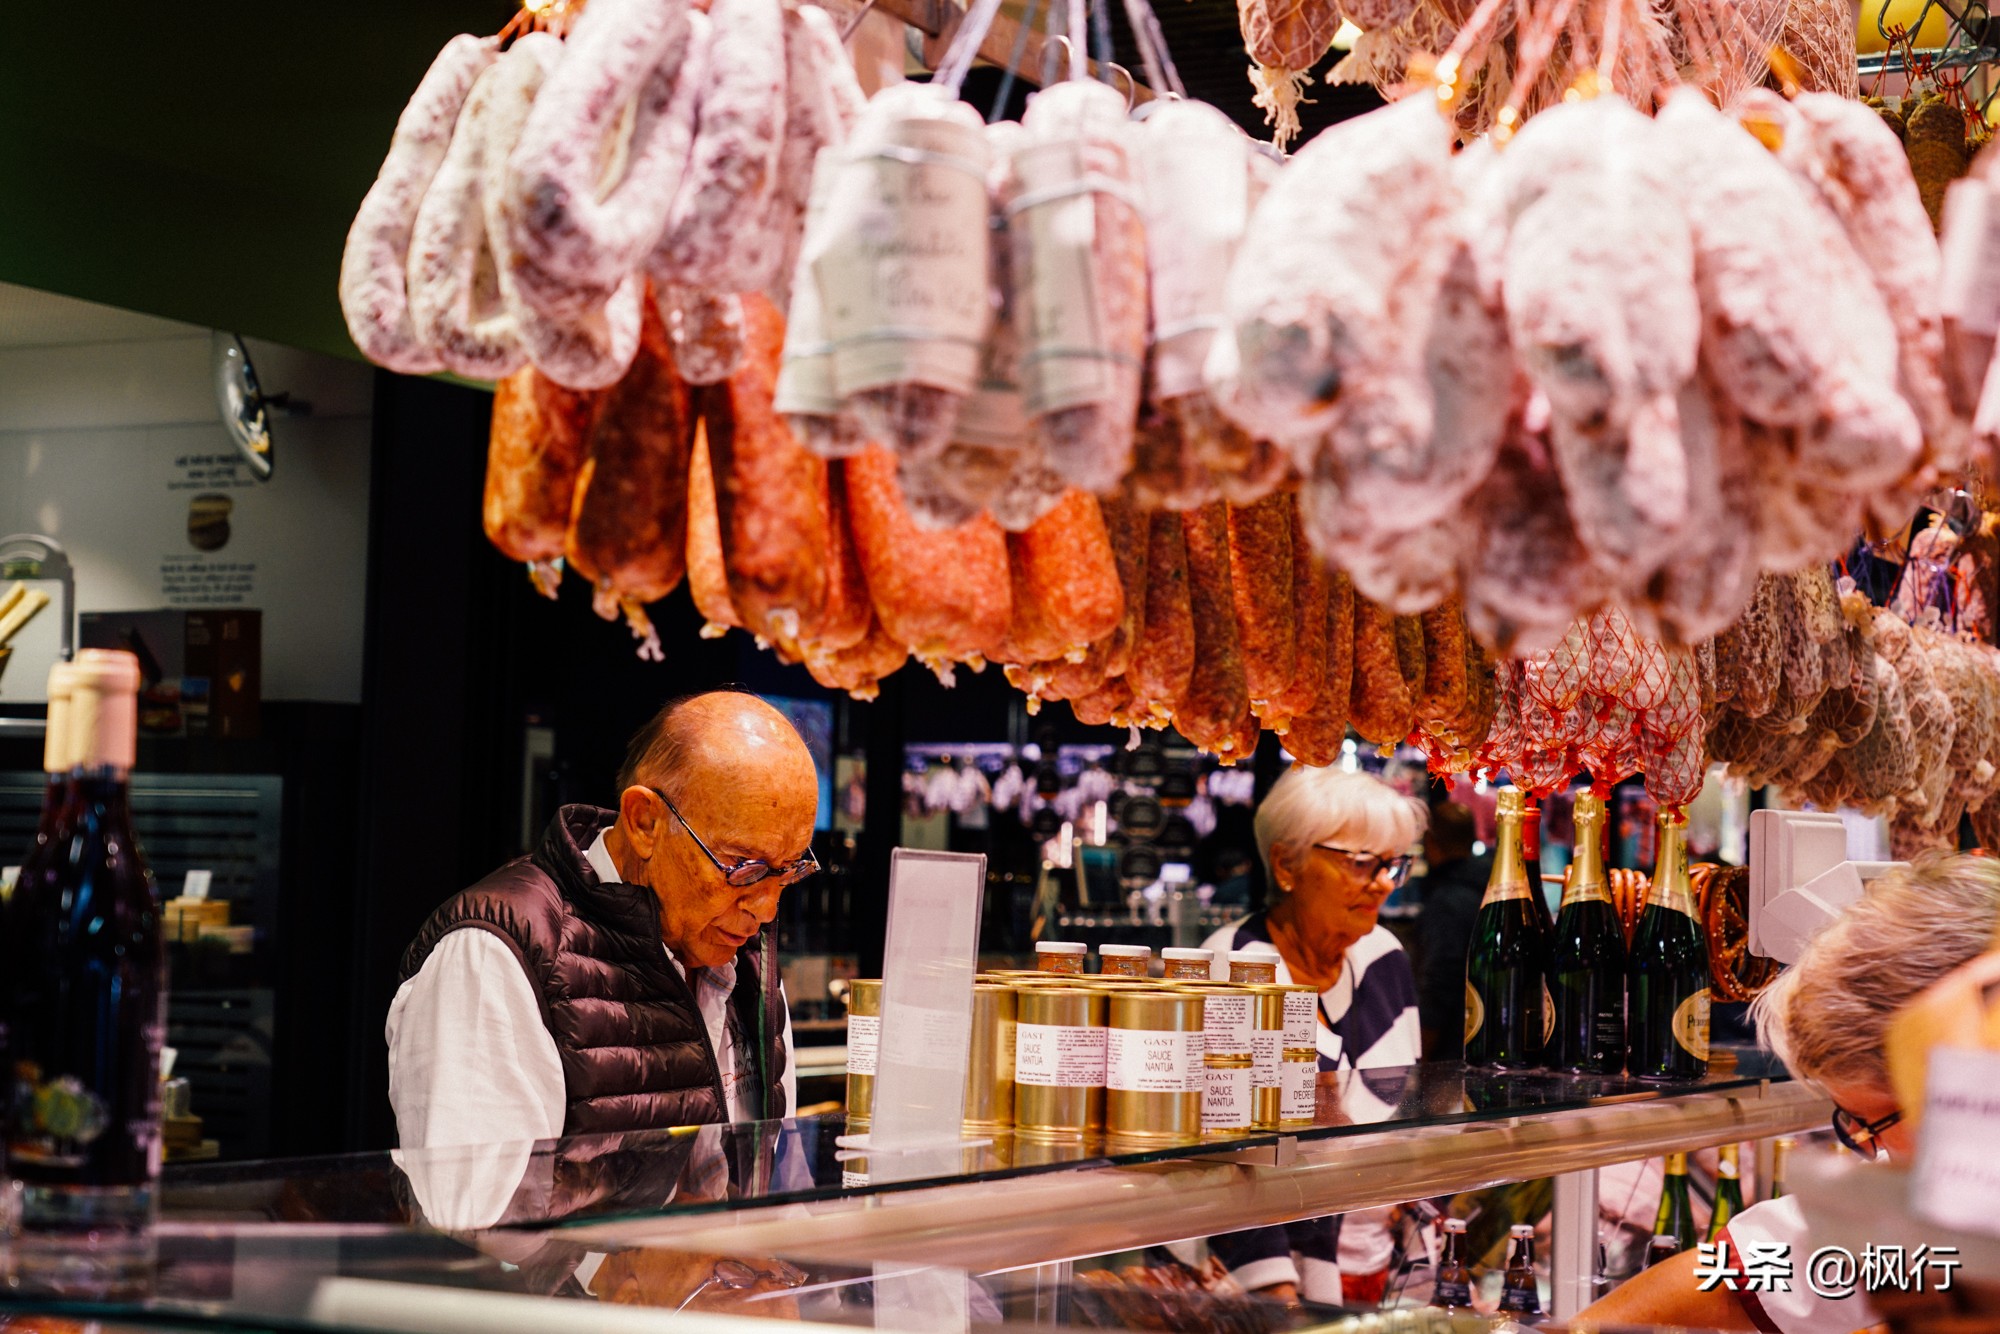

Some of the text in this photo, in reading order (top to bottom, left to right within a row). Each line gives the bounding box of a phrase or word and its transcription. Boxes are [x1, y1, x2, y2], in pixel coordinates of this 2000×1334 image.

[1021, 1032, 1043, 1040] GAST
[1144, 1038, 1174, 1046] GAST
[1023, 1043, 1041, 1054] SAUCE
[1022, 1055, 1043, 1066] NANTUA
[1147, 1050, 1171, 1061] SAUCE
[1145, 1062, 1174, 1072] NANTUA
[1210, 1086, 1232, 1096] SAUCE
[1208, 1098, 1234, 1107] NANTUA
